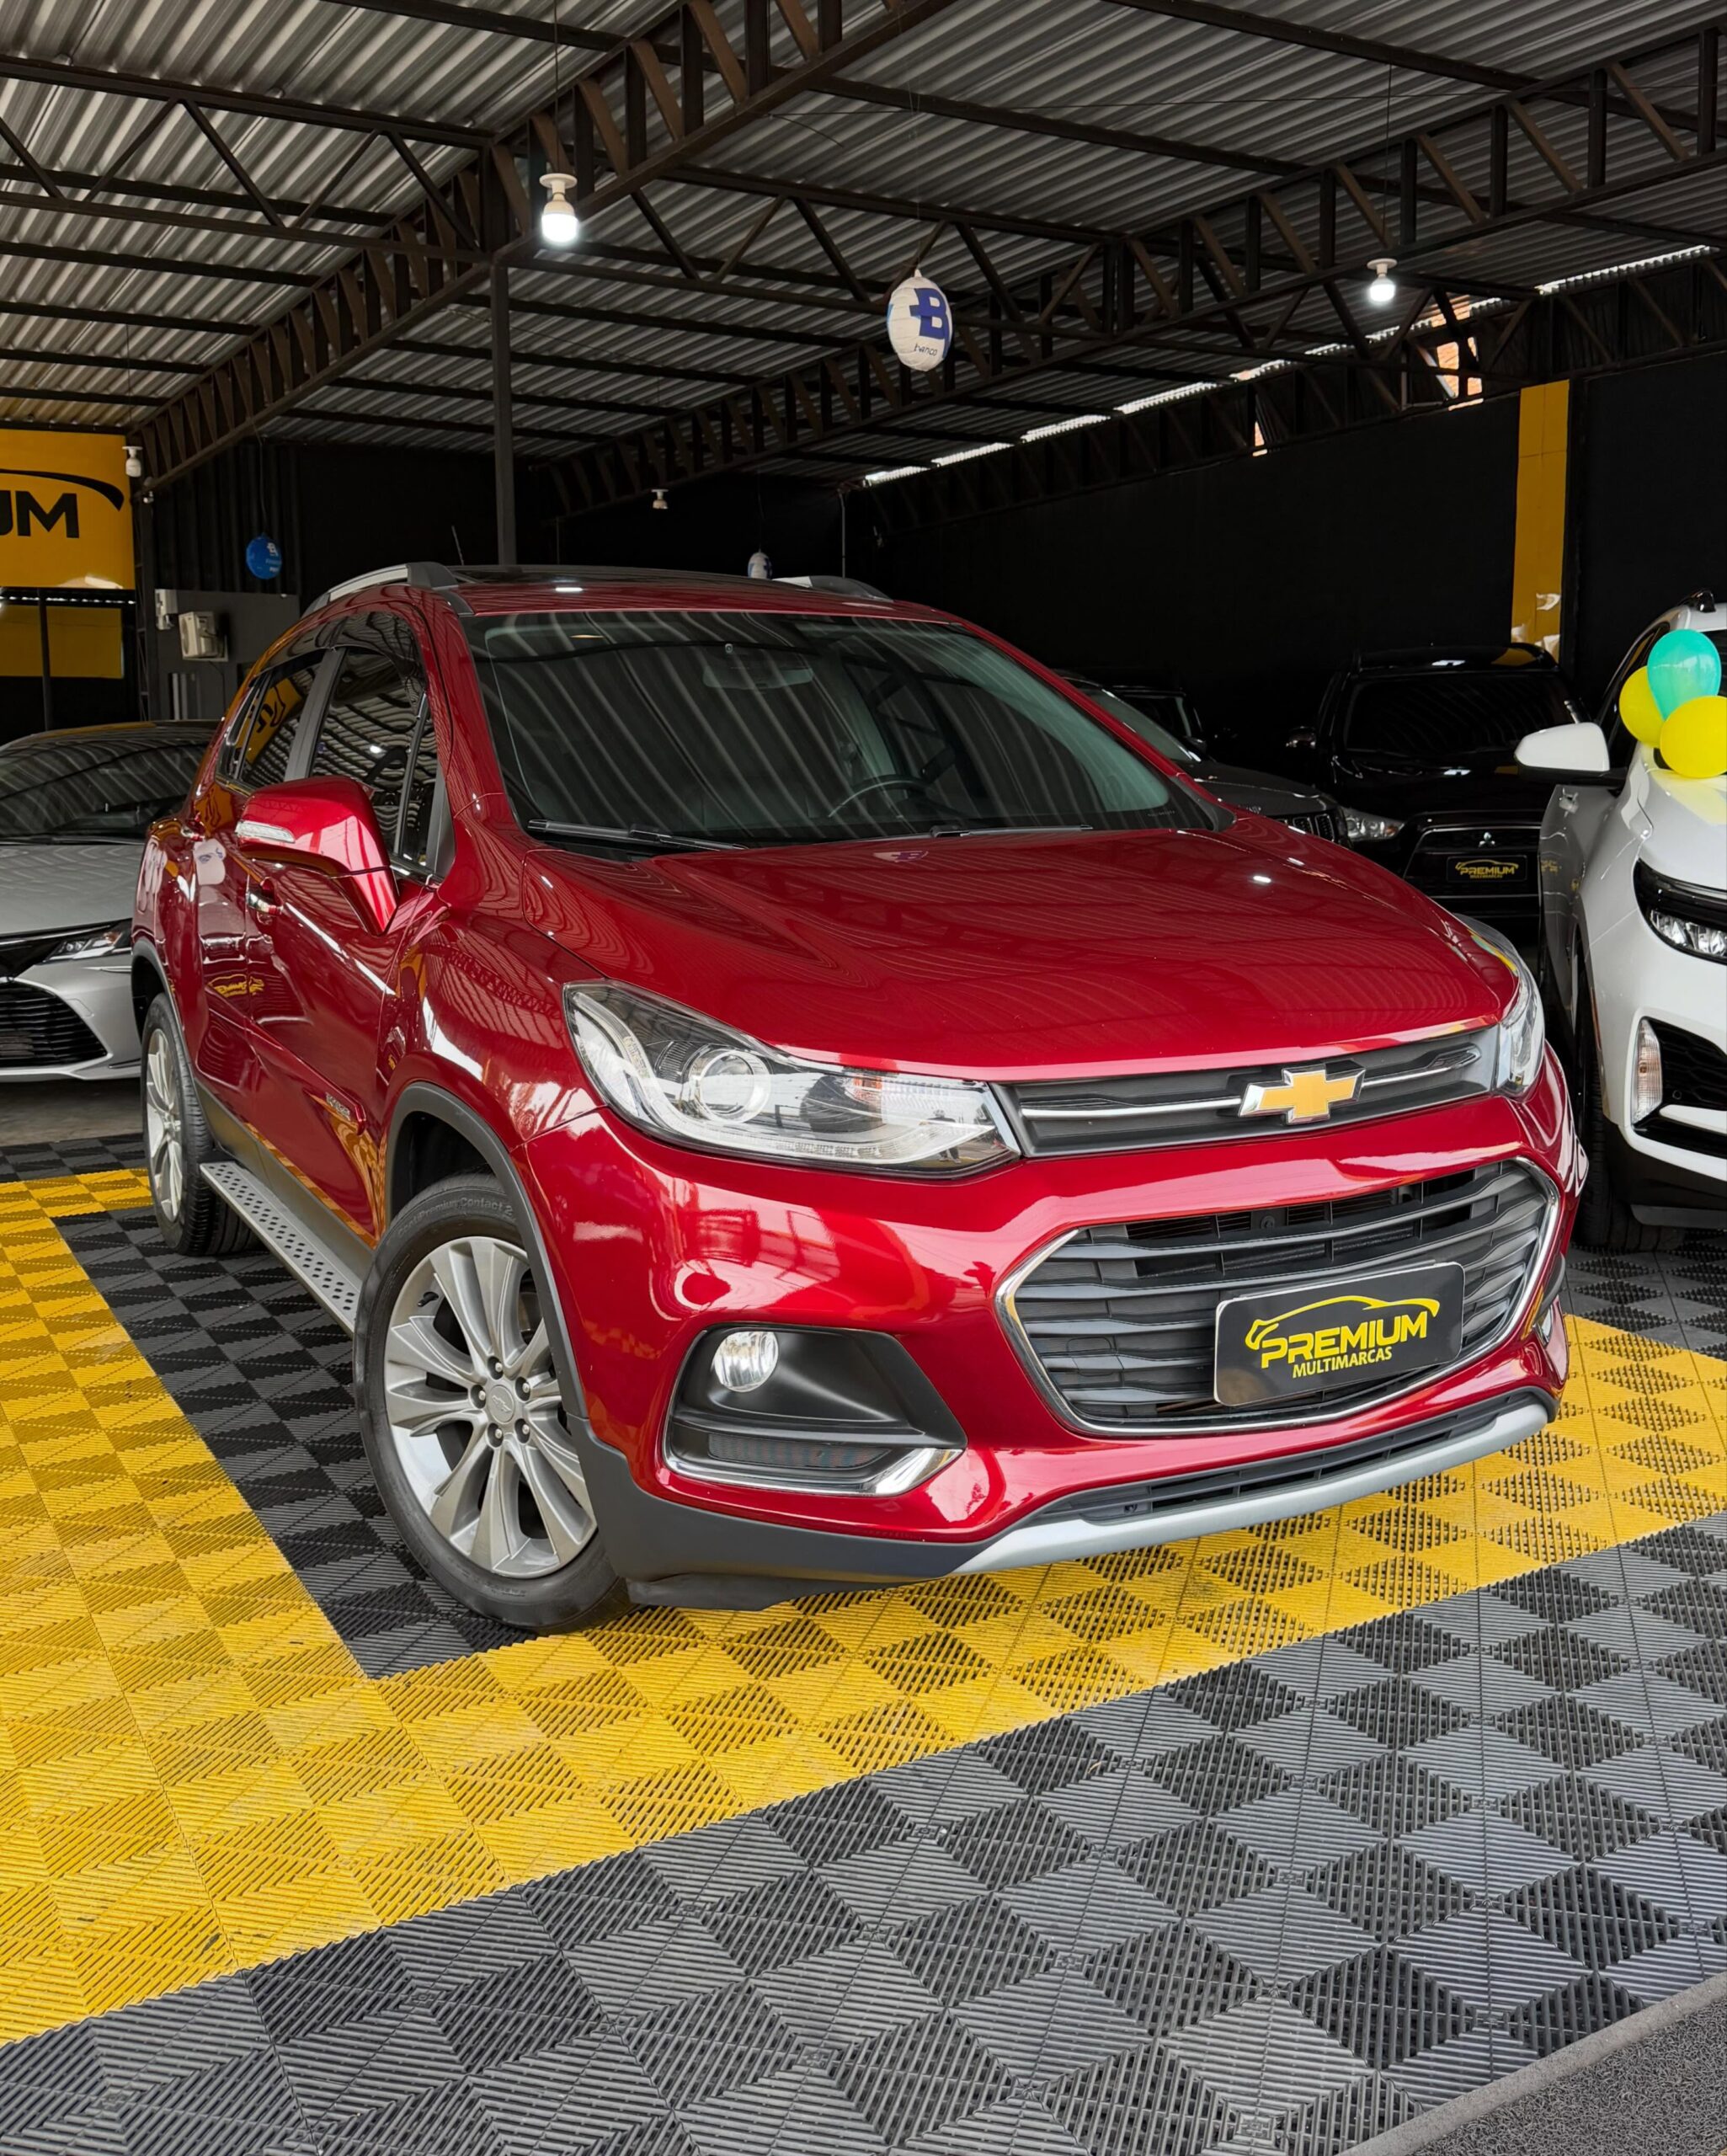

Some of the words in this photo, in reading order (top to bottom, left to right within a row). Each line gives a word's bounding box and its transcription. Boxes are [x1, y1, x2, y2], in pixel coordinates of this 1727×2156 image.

[914, 344, 938, 356] banco
[1460, 867, 1515, 875] PREMIUM
[1261, 1311, 1428, 1369] PREMIUM
[1293, 1347, 1393, 1379] MULTIMARCAS
